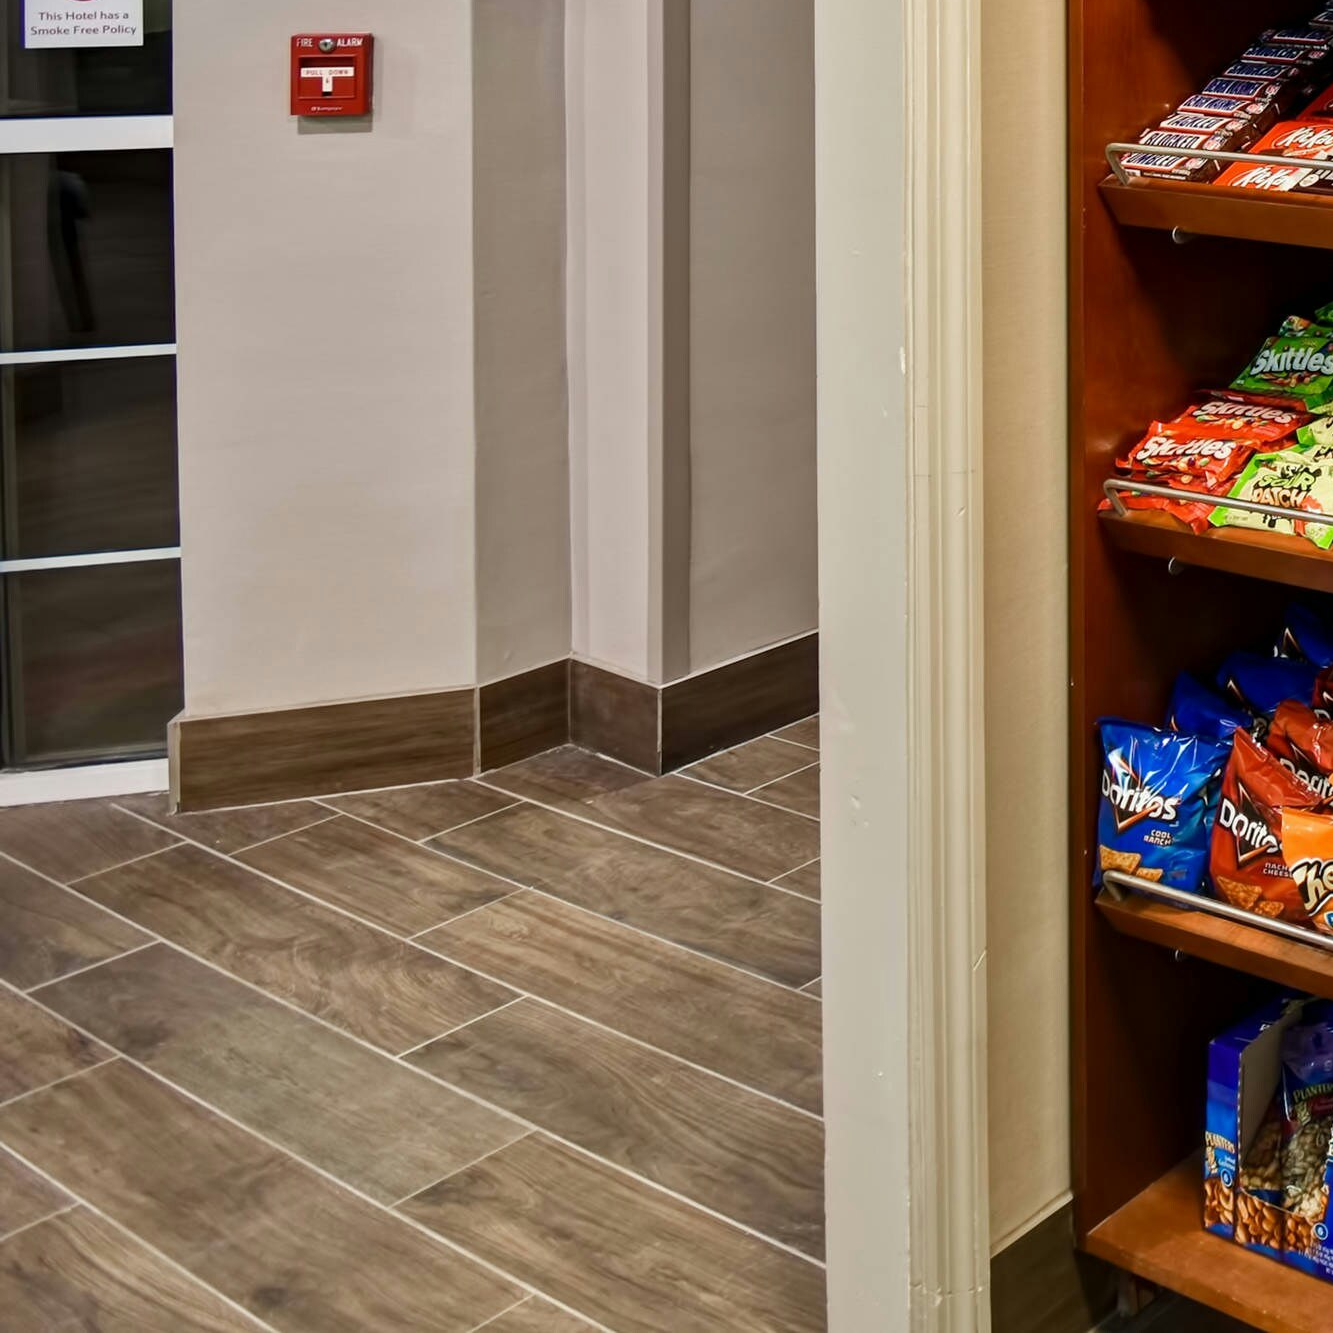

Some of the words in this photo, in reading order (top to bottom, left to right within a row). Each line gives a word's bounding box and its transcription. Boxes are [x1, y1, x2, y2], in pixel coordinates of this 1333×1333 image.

[39, 12, 63, 21] This
[66, 11, 97, 20] Hotel
[100, 11, 119, 20] has
[31, 26, 70, 36] Smoke
[73, 25, 99, 35] Free
[103, 24, 137, 36] Policy
[296, 38, 313, 47] FIRE
[337, 38, 363, 47] ALARM
[1192, 401, 1298, 424] Skittles
[1136, 436, 1237, 460] Skittles
[1101, 768, 1178, 822] Doritos
[1150, 829, 1171, 839] COOL
[1143, 835, 1172, 846] RANCH
